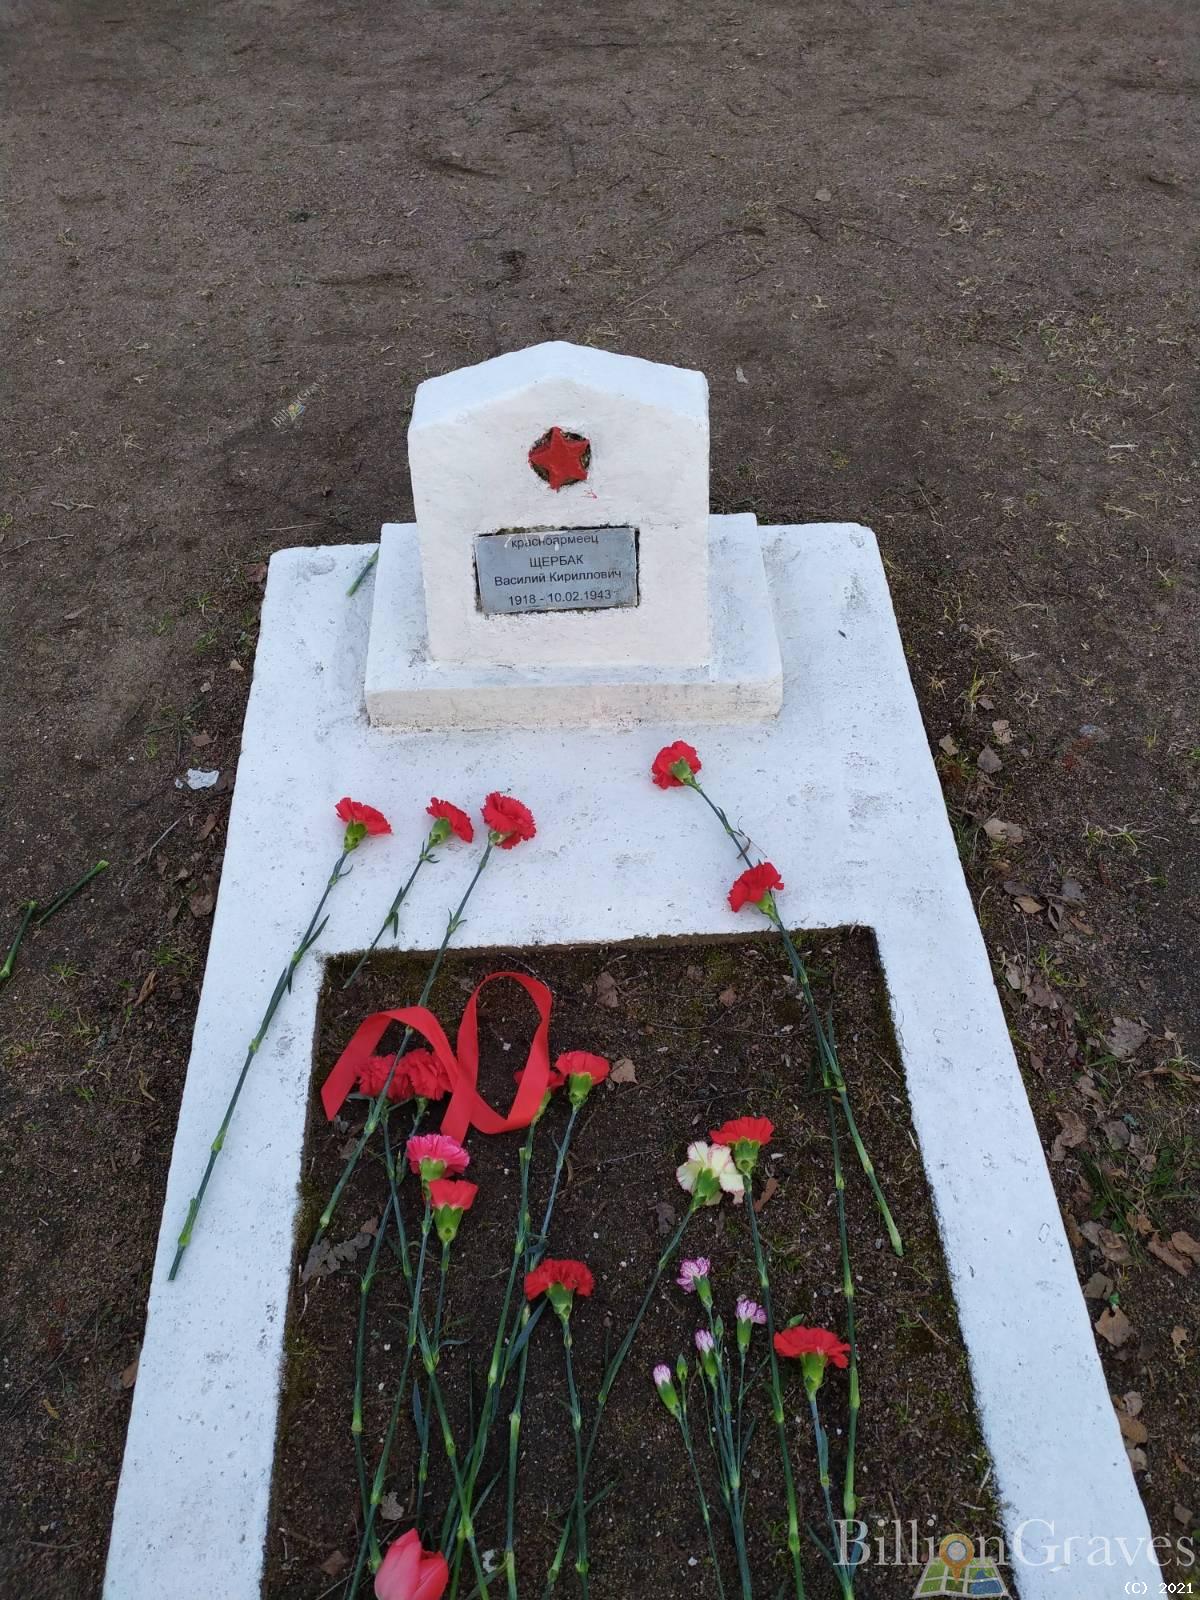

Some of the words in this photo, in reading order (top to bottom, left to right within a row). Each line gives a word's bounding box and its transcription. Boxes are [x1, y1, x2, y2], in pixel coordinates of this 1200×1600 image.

[511, 534, 599, 549] красноармеец
[529, 554, 584, 569] ЩЕРБАК
[494, 574, 546, 587] Василий
[549, 570, 622, 584] Кириллович
[508, 594, 537, 606] 1918
[548, 589, 612, 603] 10.02.1943
